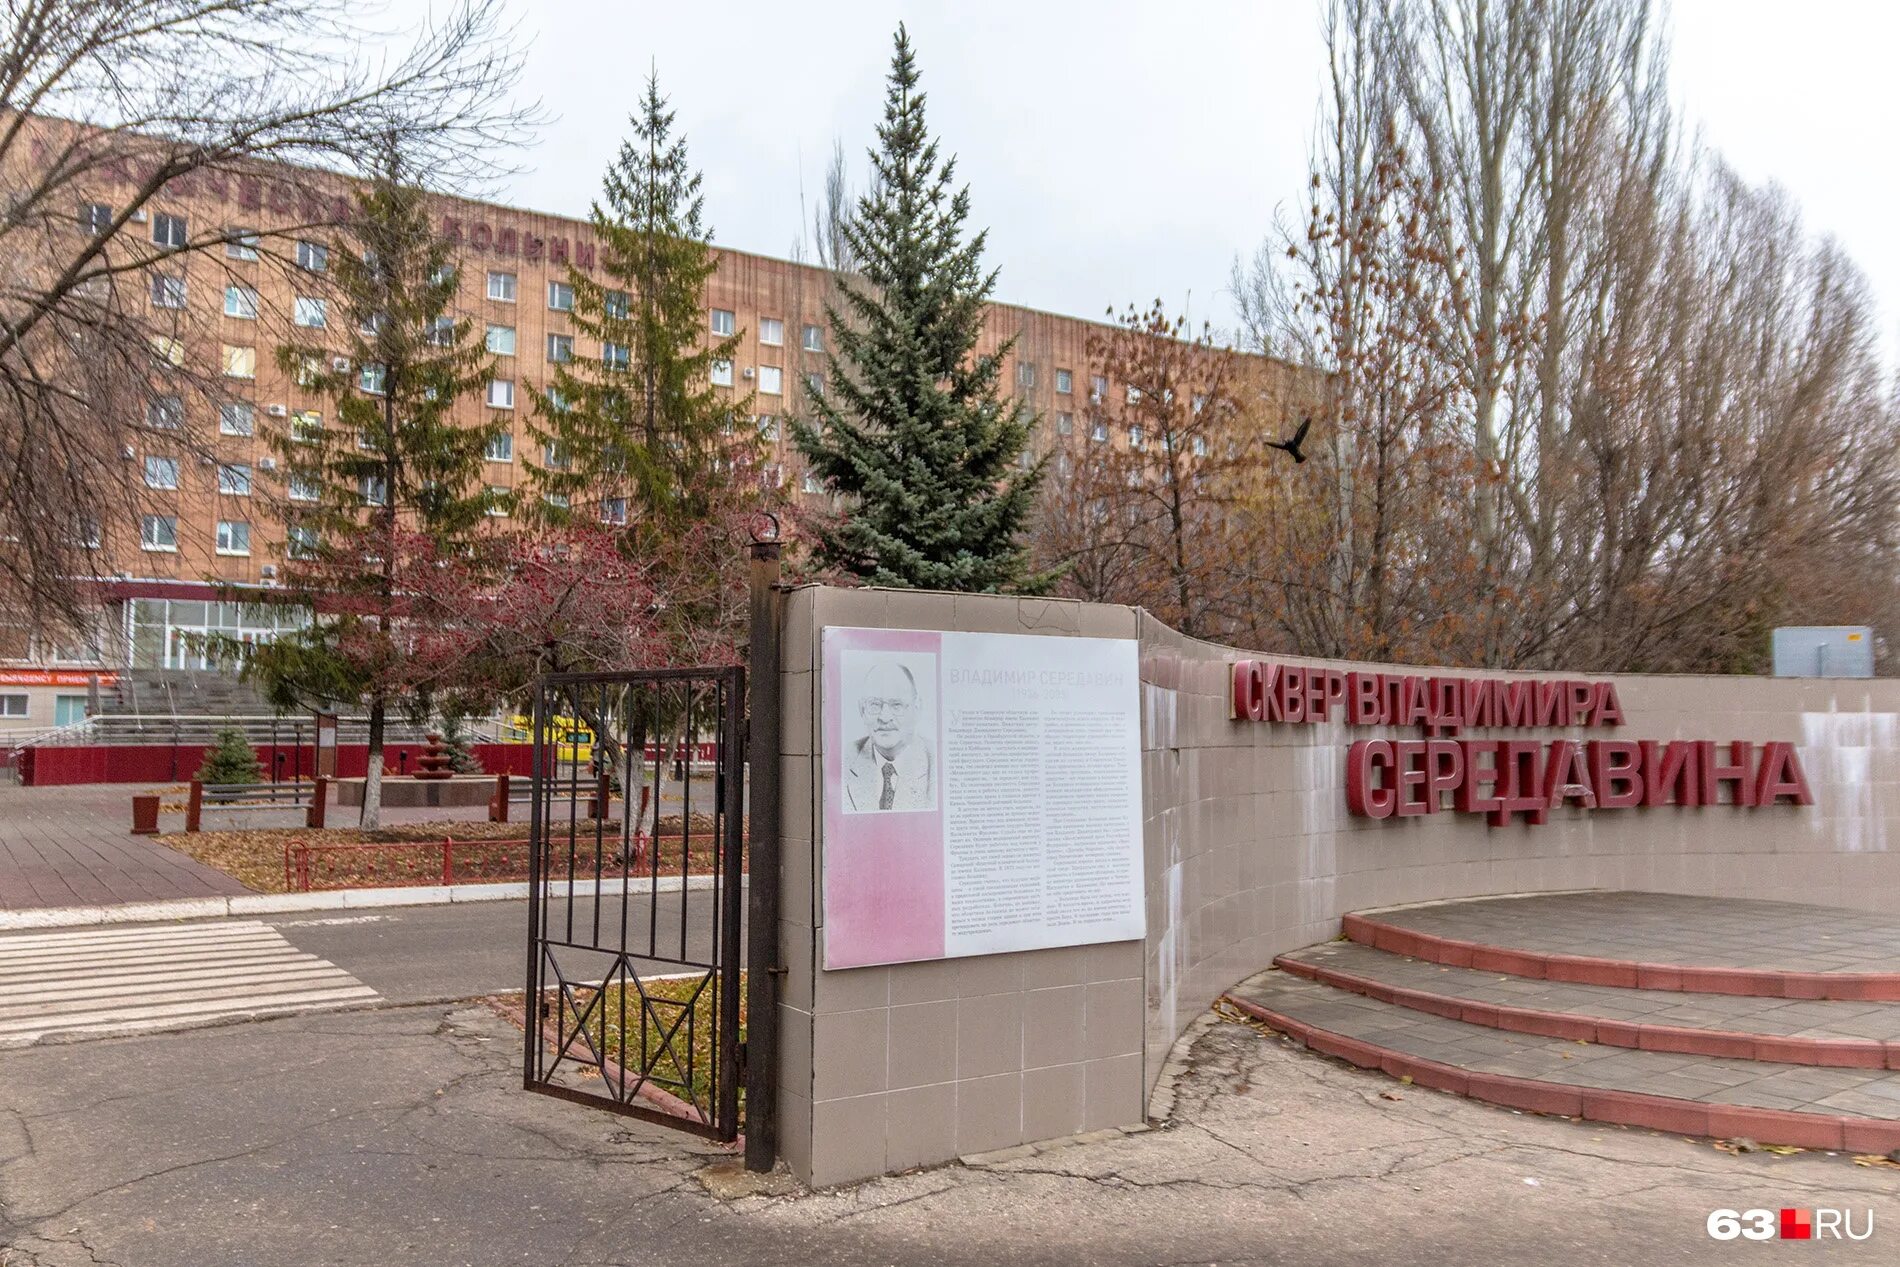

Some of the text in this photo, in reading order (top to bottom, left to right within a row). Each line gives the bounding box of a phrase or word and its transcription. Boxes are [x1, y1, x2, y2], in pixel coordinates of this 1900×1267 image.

[950, 668, 1124, 687] ВЛАДИМИР СЕРЕДАВИН
[1234, 659, 1627, 738] СКВЕР ВЛАДИМИРА
[1346, 738, 1815, 828] СЕРЕДАВИНА
